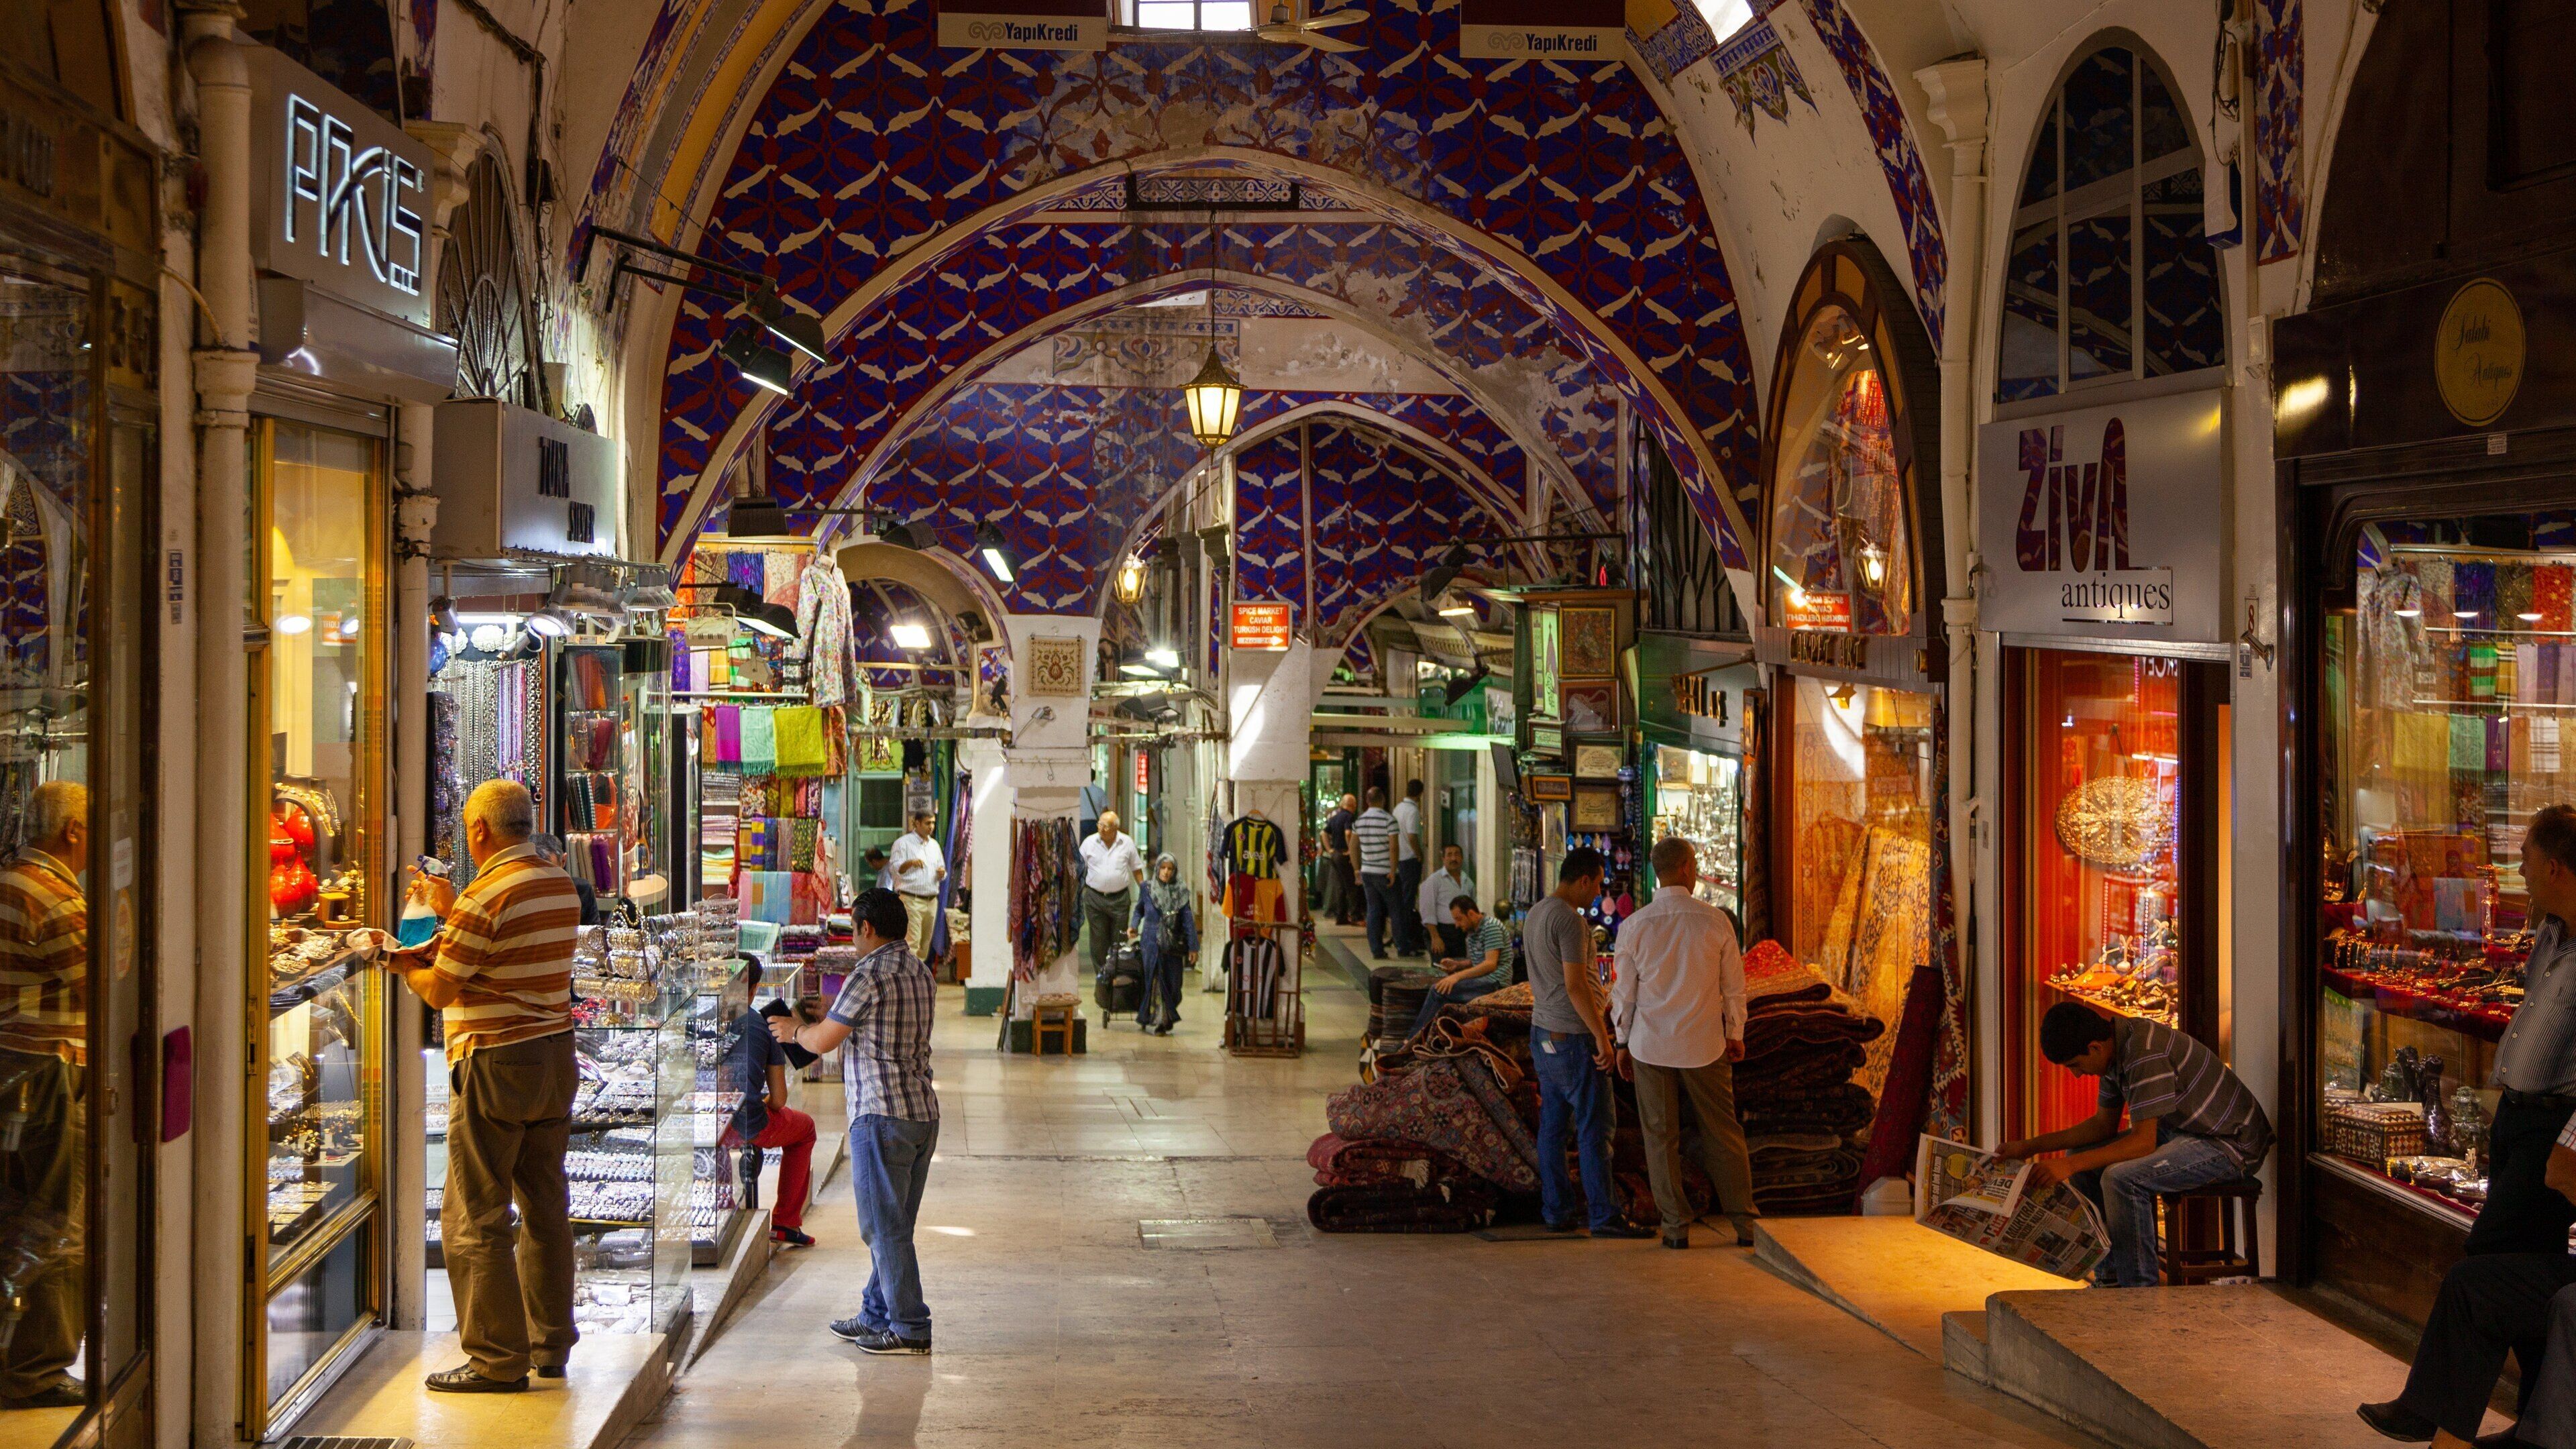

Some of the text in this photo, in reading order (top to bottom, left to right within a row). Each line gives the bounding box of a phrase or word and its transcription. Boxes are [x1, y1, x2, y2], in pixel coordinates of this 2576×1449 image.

[2061, 572, 2170, 619] antiques
[1238, 607, 1283, 615] SPICE MARKET
[1234, 626, 1287, 634] TURKISH DELIGHT
[1789, 631, 1864, 670] CARPET ART
